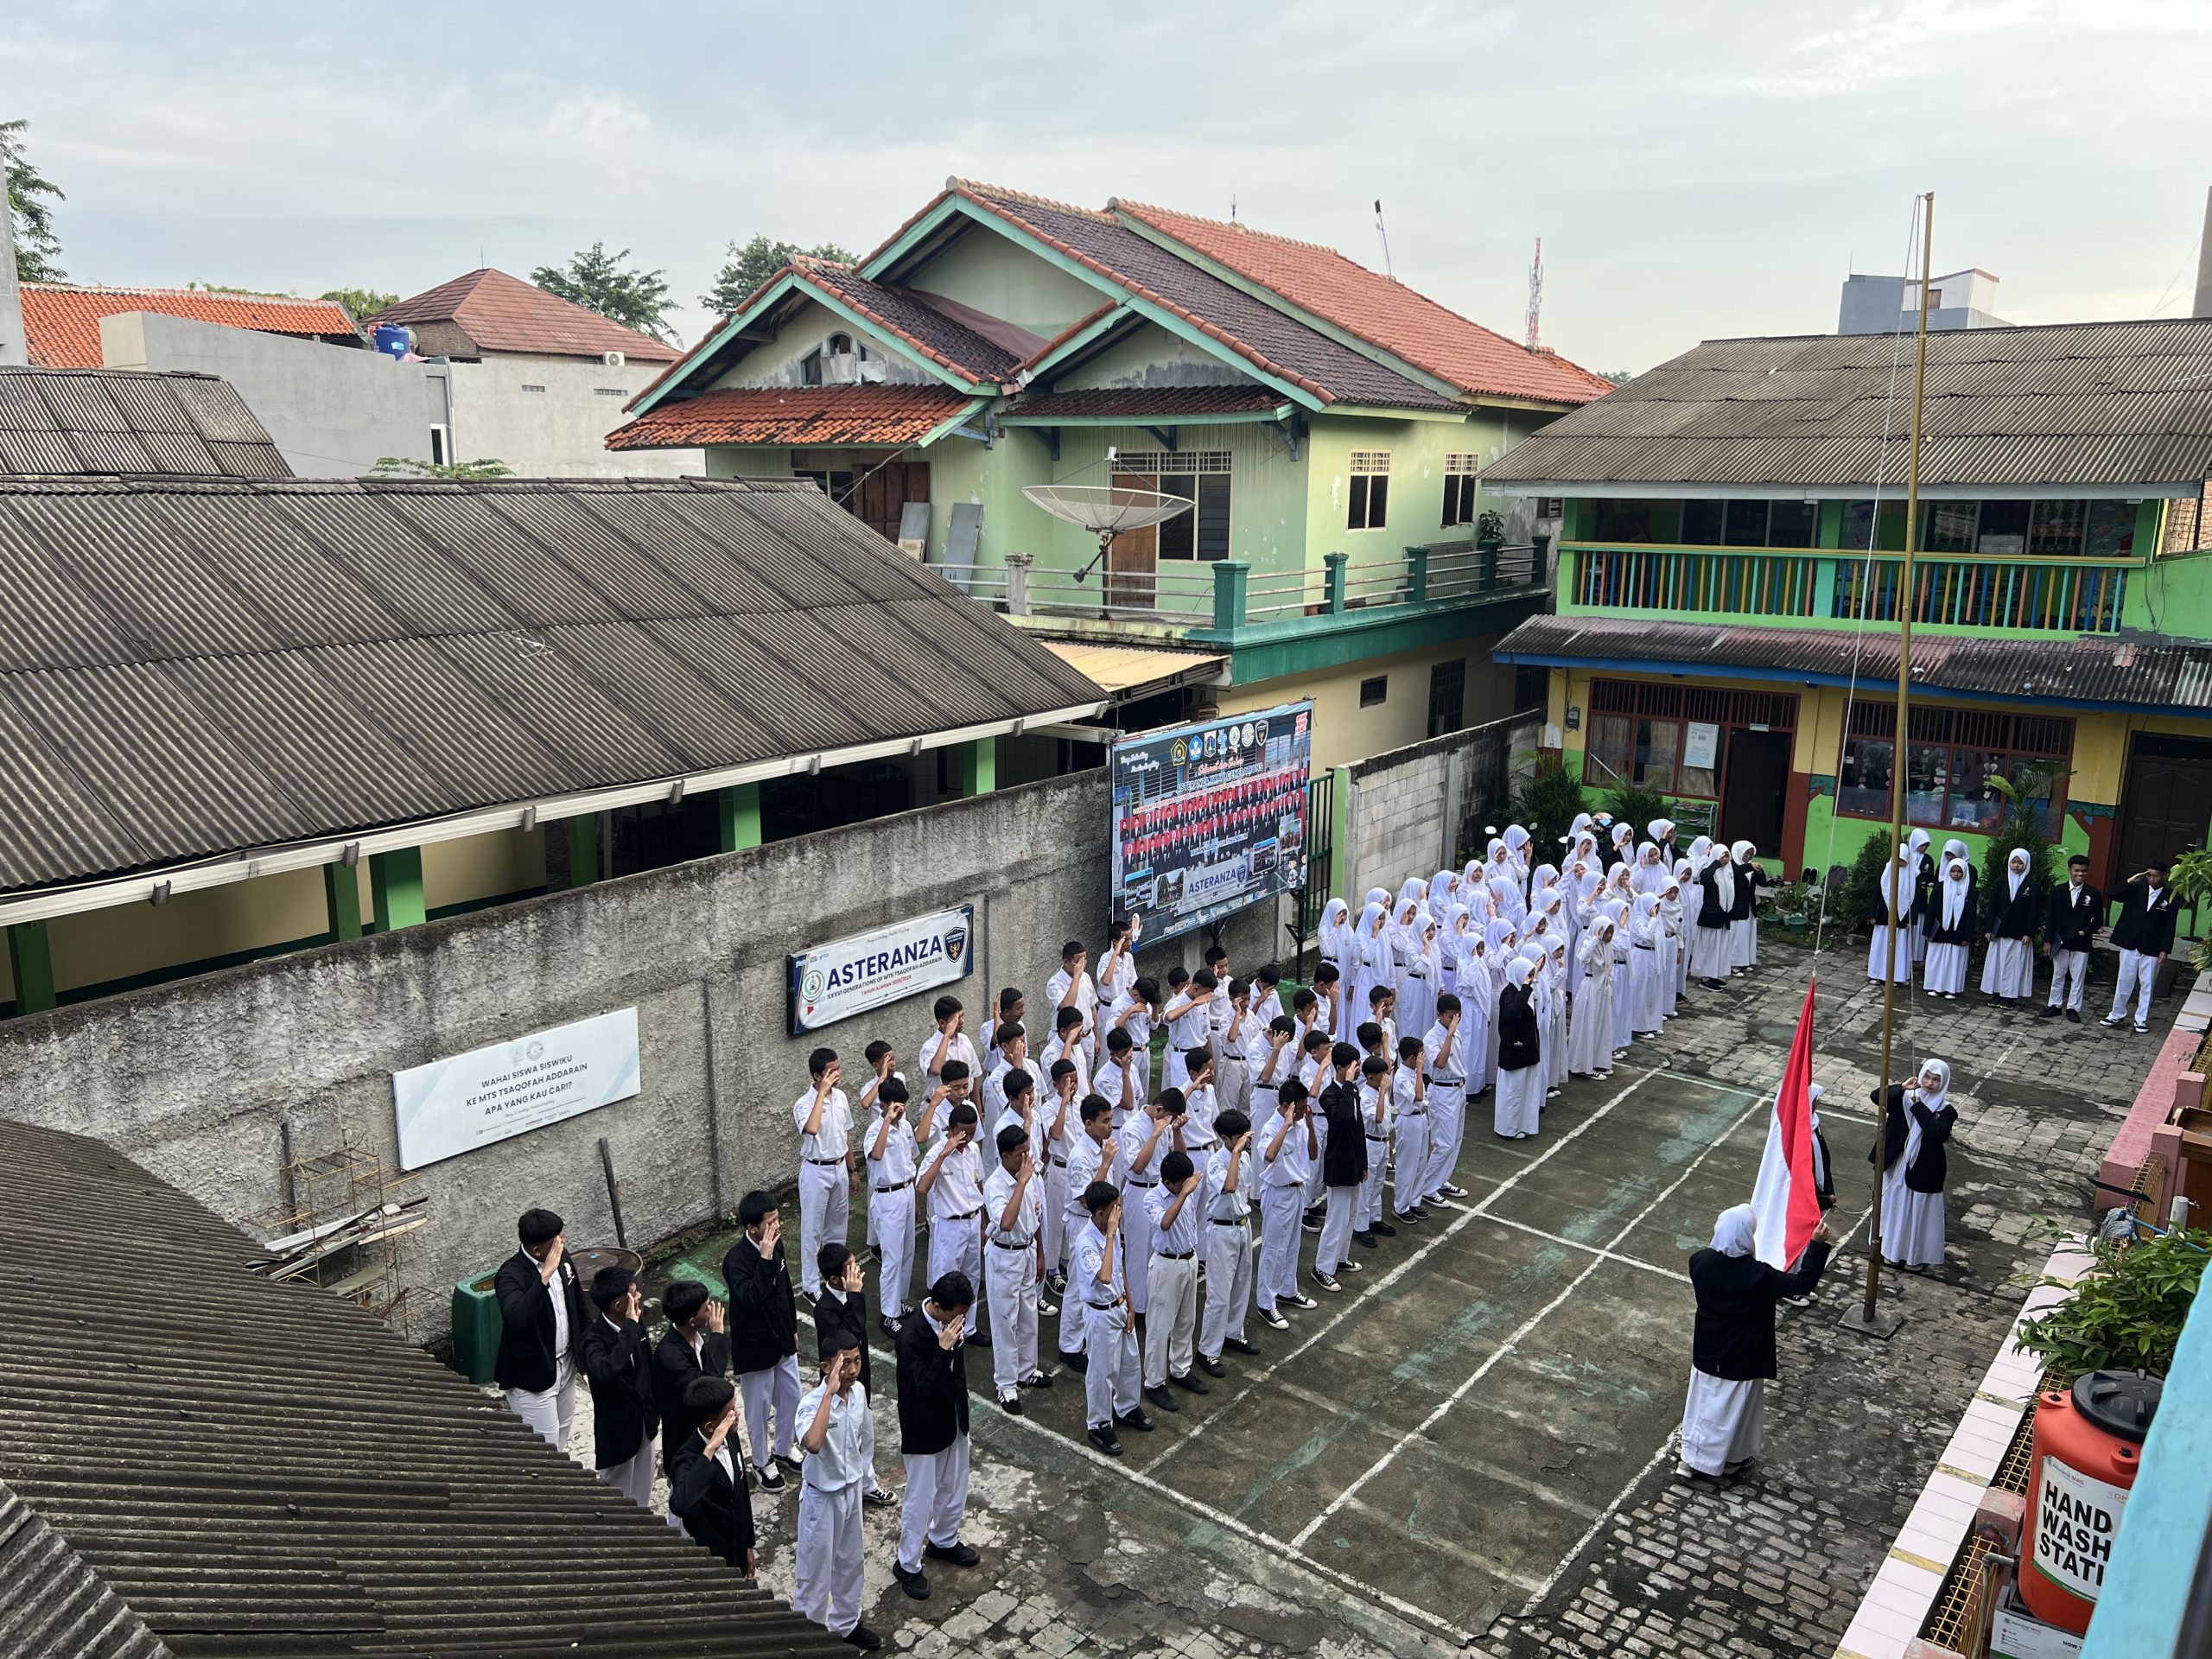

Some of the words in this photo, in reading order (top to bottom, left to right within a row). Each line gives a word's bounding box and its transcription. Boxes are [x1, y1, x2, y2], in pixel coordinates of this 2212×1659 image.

[1227, 762, 1263, 779] GENERATIONS
[1188, 868, 1236, 894] ASTERANZA
[827, 935, 943, 990] ASTERANZA
[827, 990, 843, 1000] XXXVI
[843, 978, 876, 994] GENERATIONS
[894, 963, 919, 977] TSAQOFAH
[918, 956, 943, 969] ADDARAIN
[861, 988, 875, 996] TAHUN
[875, 982, 893, 992] AJARAN
[466, 1096, 477, 1107] KE
[479, 1091, 497, 1103] MTS
[498, 1076, 544, 1096] TSAQOFAH
[545, 1063, 588, 1083] ADDARAIN
[481, 1073, 511, 1088] WAHAI
[512, 1065, 538, 1079] SISWA
[539, 1054, 573, 1071] SISWIKU
[485, 1103, 503, 1116] APA
[504, 1096, 529, 1109] YANG
[530, 1089, 548, 1102] KAU
[549, 1081, 573, 1095] CARI?
[2071, 1475, 2084, 1485] MAG
[2044, 1479, 2112, 1534] HAND
[2043, 1504, 2111, 1562] WASH
[2039, 1532, 2104, 1587] STATI
[2063, 1640, 2078, 1649] HOW
